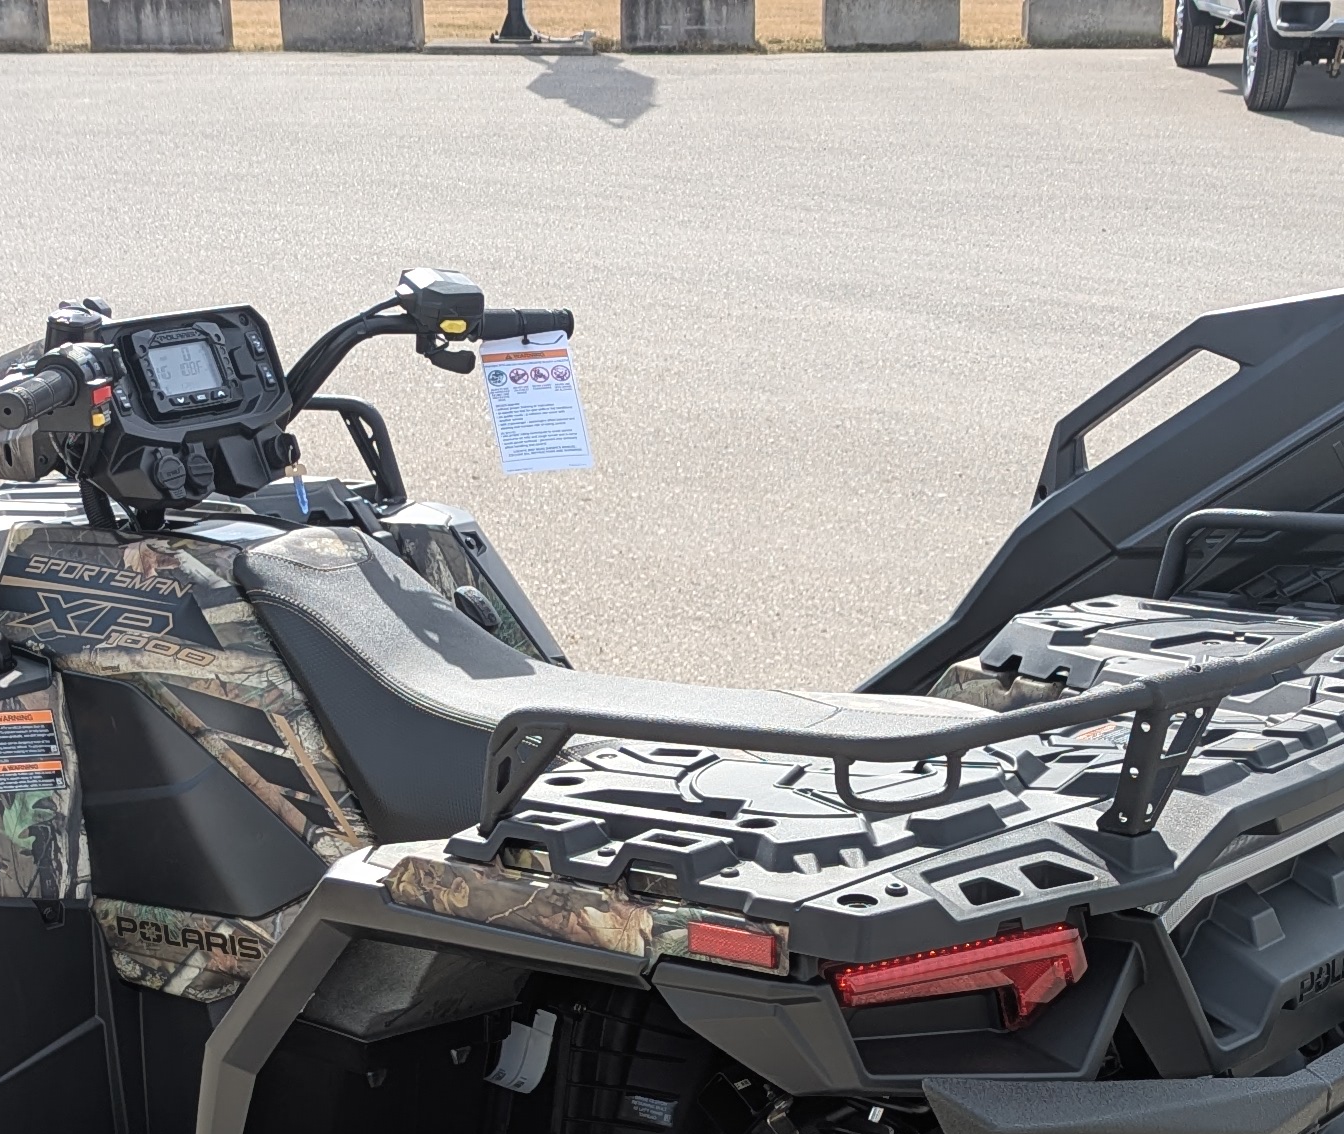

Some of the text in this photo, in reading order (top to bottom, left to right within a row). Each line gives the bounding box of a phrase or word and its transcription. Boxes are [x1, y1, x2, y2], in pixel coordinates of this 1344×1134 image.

[24, 554, 193, 598] SPORTSMAN
[6, 591, 173, 639] XP
[105, 631, 217, 667] 1000
[7, 763, 39, 771] WARNING
[116, 916, 262, 960] POLARIS
